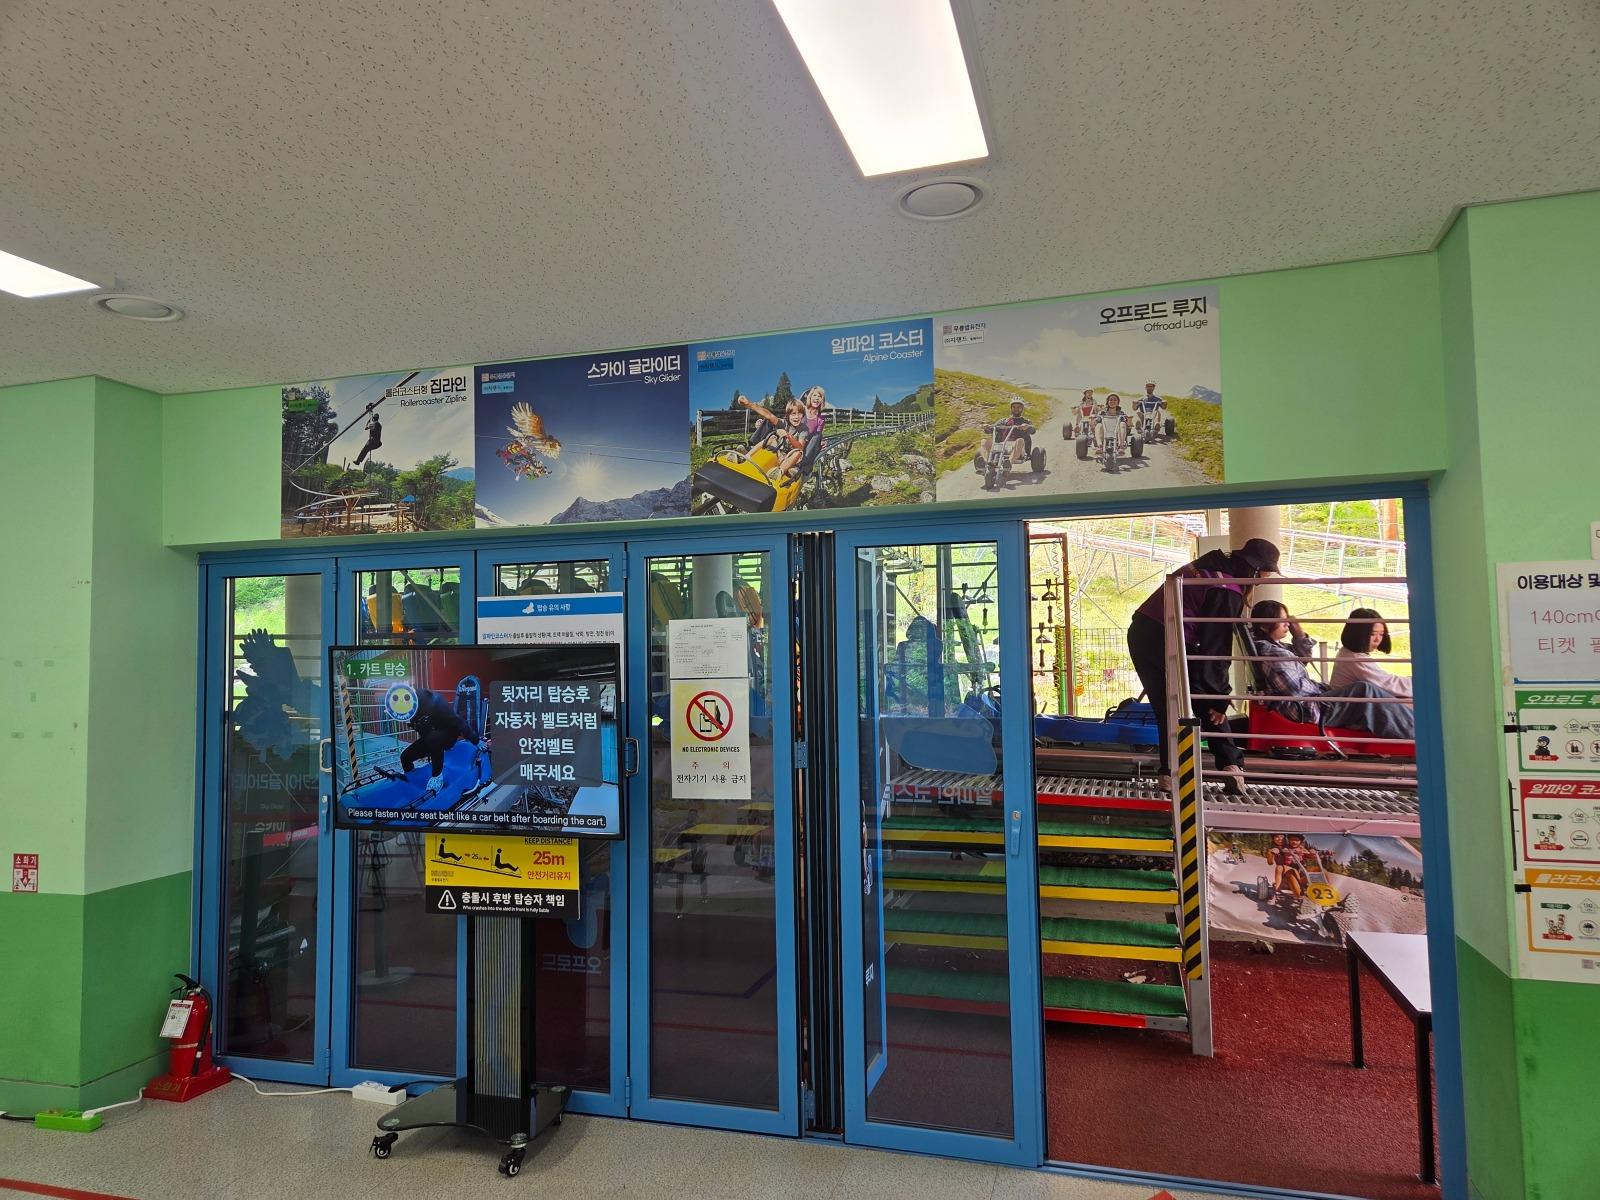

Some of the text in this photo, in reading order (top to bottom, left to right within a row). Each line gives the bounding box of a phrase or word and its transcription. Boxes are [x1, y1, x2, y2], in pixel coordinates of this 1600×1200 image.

[1100, 296, 1206, 324] 오프로드 루지
[1144, 319, 1208, 332] Offroad Luge
[831, 328, 924, 354] 알파인 코스터
[862, 350, 924, 364] Alpine Coaster
[588, 360, 625, 378] 스카이
[628, 354, 680, 374] 글라이더
[430, 376, 466, 394] 집라인
[644, 374, 681, 384] Sky Glider
[400, 394, 468, 407] Rollercoaster Zipline
[1517, 574, 1584, 590] 이용대상
[1538, 636, 1576, 654] 티켓
[346, 662, 406, 677] 1. 카트 탑승
[502, 686, 590, 704] 뒷자리 탑승후
[1523, 694, 1587, 704] 오프로드
[495, 712, 597, 730] 자동차 벨트처럼
[518, 738, 575, 756] 안전벨트
[520, 764, 576, 782] 매주세요
[676, 774, 746, 784] 전자기기 사용 금지
[1528, 784, 1577, 794] 알파인
[348, 808, 373, 817] Please
[375, 809, 398, 818] fasten
[401, 812, 418, 820] your
[420, 812, 438, 820] seat
[440, 812, 454, 820] belt
[456, 812, 470, 820] like
[479, 814, 492, 822] car
[494, 813, 510, 822] belt
[512, 814, 530, 823] after
[532, 815, 568, 826] boarding
[570, 816, 584, 825] the
[586, 816, 606, 826] cart.
[15, 856, 36, 865] 소화기
[532, 851, 564, 866] 25m
[528, 871, 571, 880] 안전거리유지
[462, 892, 565, 906] 충돌시 후방 탑승자 책임
[1313, 888, 1334, 900] 23
